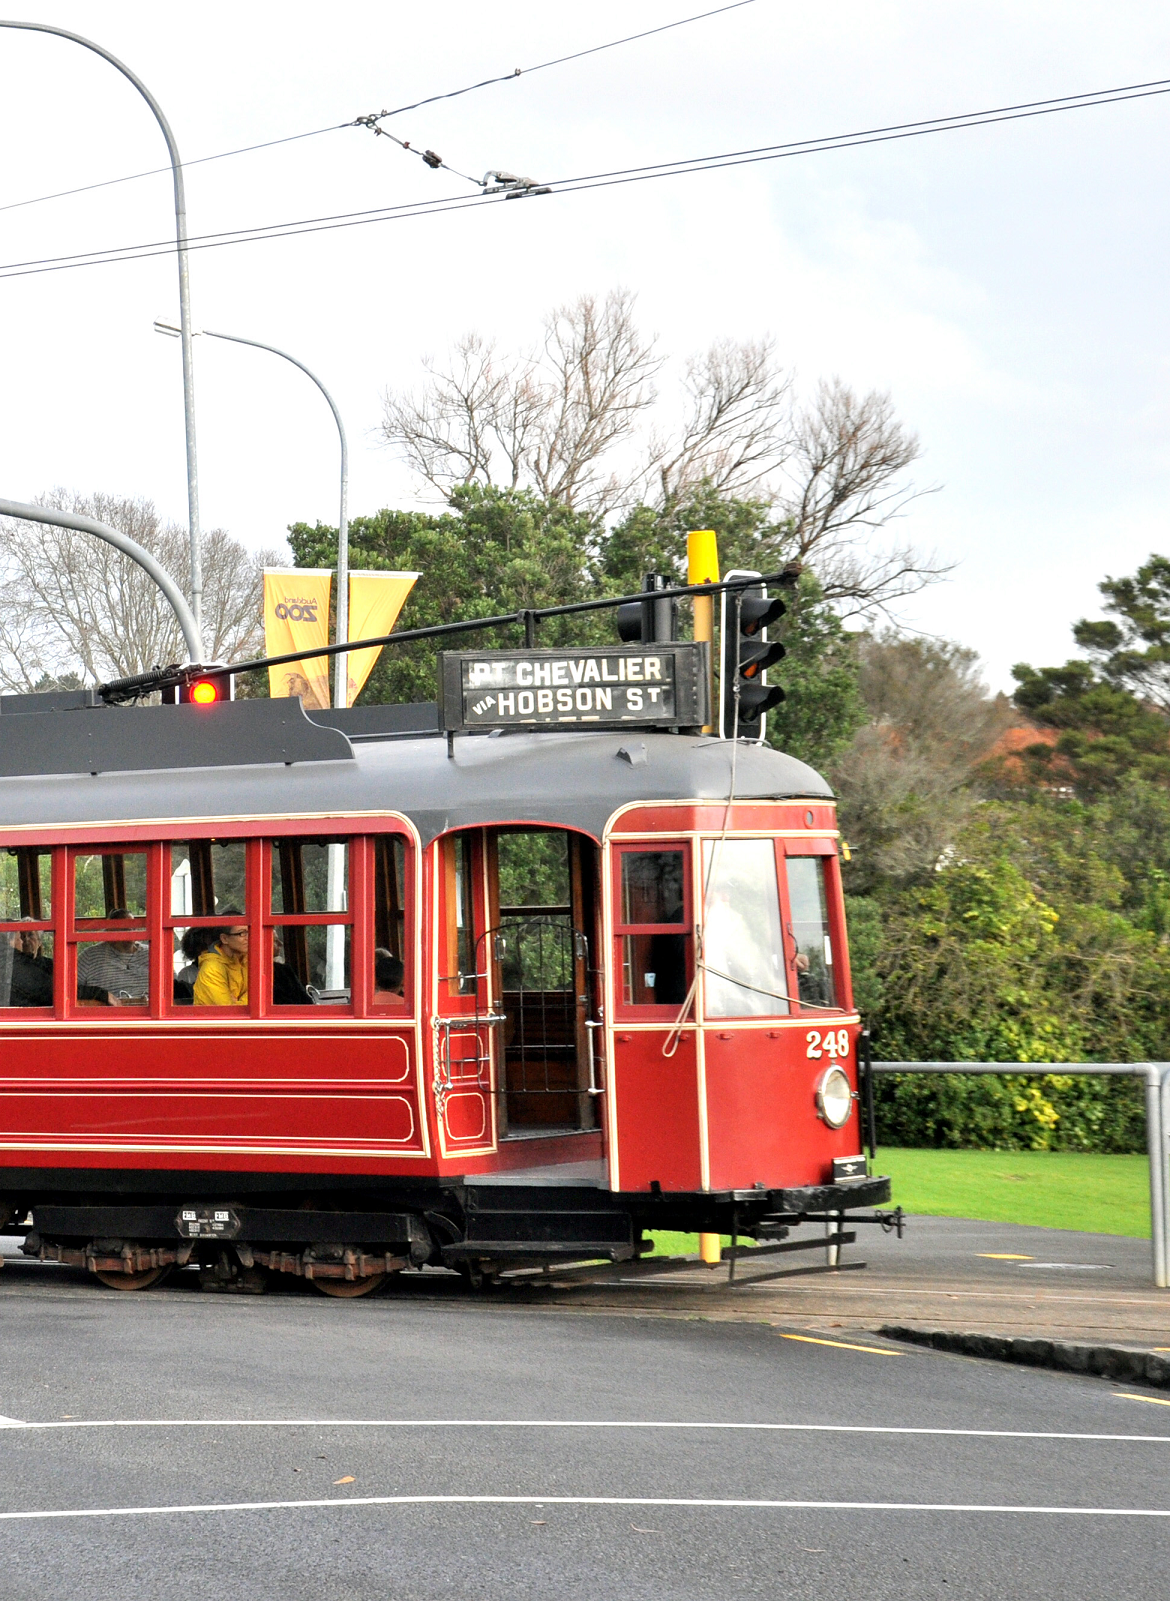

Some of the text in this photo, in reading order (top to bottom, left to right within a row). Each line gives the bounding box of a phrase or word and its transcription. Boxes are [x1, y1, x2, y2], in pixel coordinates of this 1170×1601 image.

[473, 657, 662, 686] PT CHEVALIER
[472, 687, 661, 716] VIA HOBSON ST
[806, 1029, 850, 1059] 248
